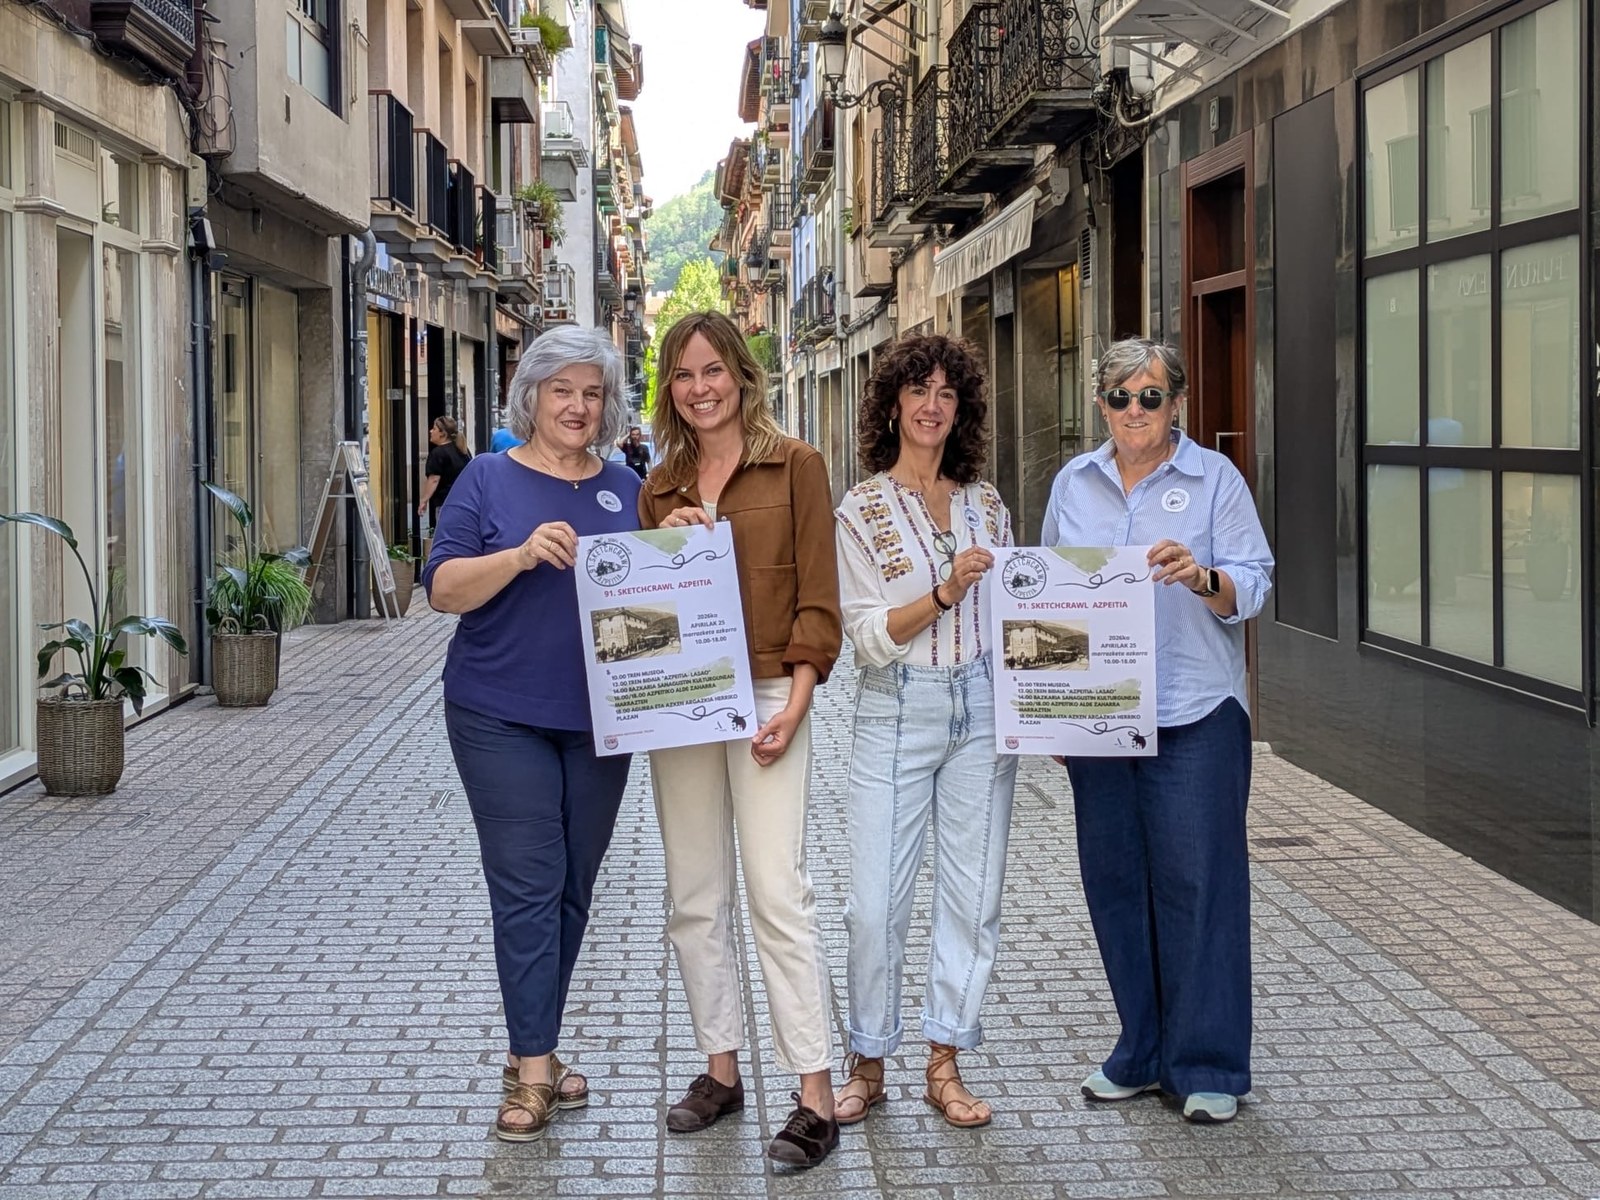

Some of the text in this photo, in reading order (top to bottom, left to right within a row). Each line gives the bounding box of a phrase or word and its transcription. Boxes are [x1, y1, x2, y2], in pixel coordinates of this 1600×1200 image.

[1211, 105, 1216, 126] 2
[589, 545, 628, 568] SKETCHCRAWL
[1005, 559, 1044, 582] SKETCHCRAWL
[604, 579, 712, 598] 91. SKETCHCRAWL AZPEITIA
[1092, 601, 1128, 609] AZPEITIA
[690, 621, 717, 629] APIRILAK
[695, 636, 727, 645] 10.00-18.00
